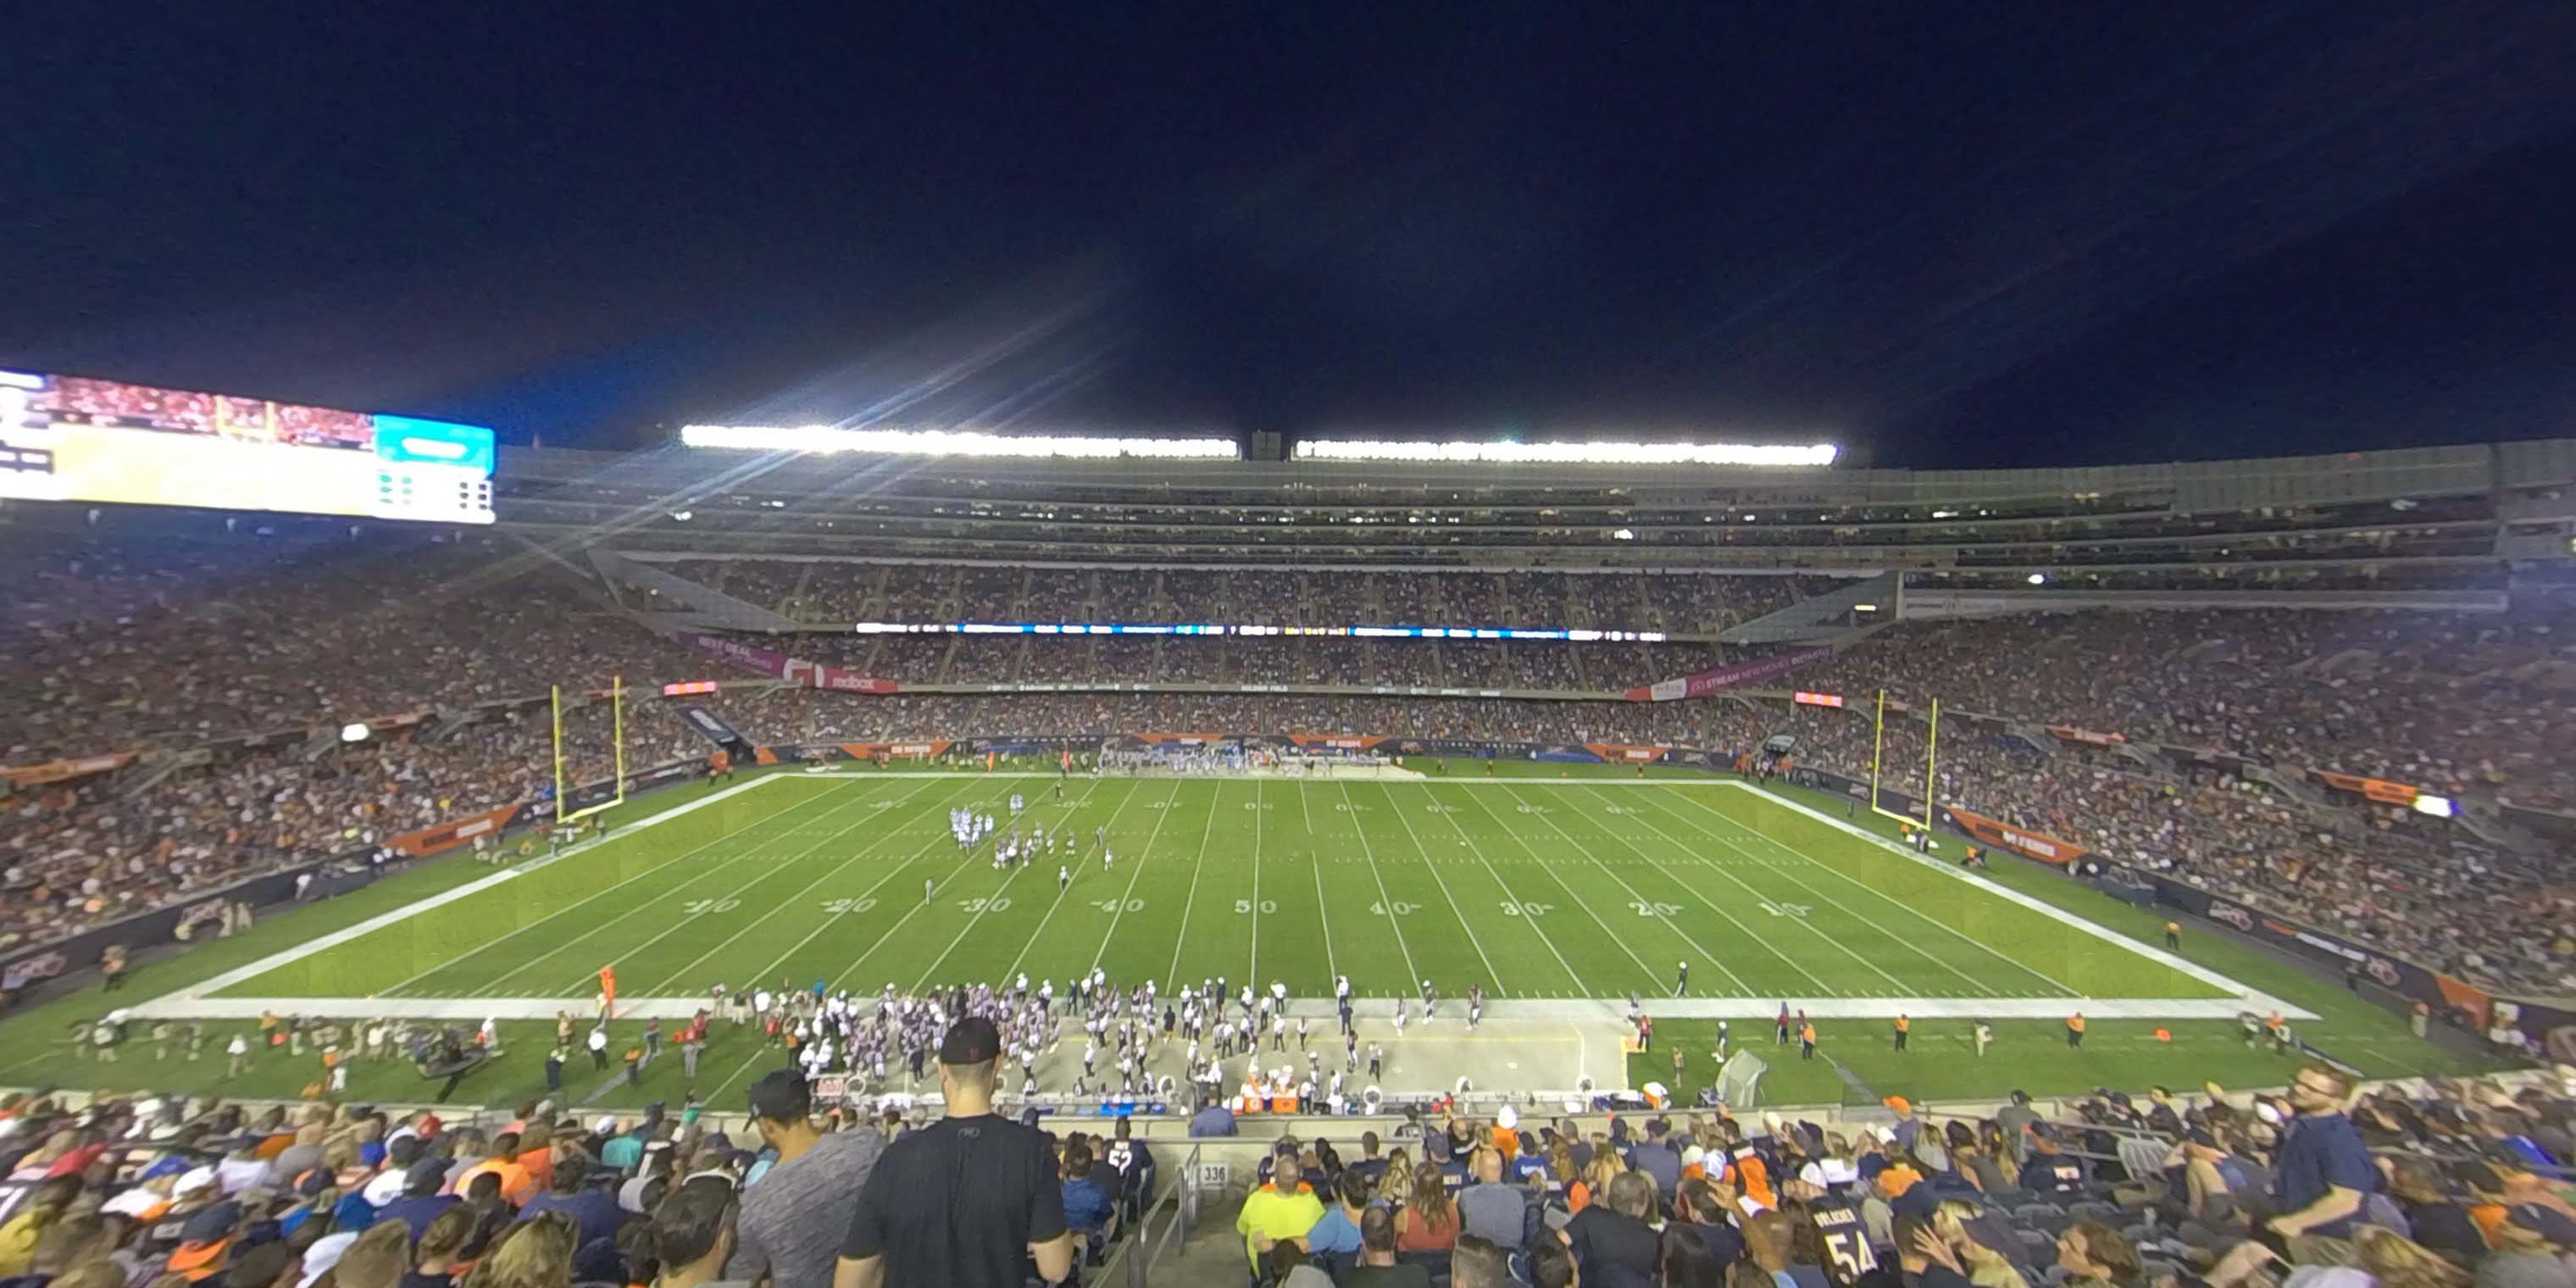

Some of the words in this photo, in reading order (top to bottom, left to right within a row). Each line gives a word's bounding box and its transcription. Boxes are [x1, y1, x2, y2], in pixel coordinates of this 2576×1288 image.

[832, 675, 874, 689] redbox
[963, 898, 1012, 913] 30
[1101, 898, 1144, 913] 40
[1234, 899, 1277, 914] 50
[1369, 901, 1411, 916] 40
[1500, 902, 1544, 916] 30
[1628, 902, 1679, 916] 20
[1108, 1149, 1132, 1176] 52
[1204, 1166, 1225, 1180] 336
[1824, 1230, 1879, 1285] 54
